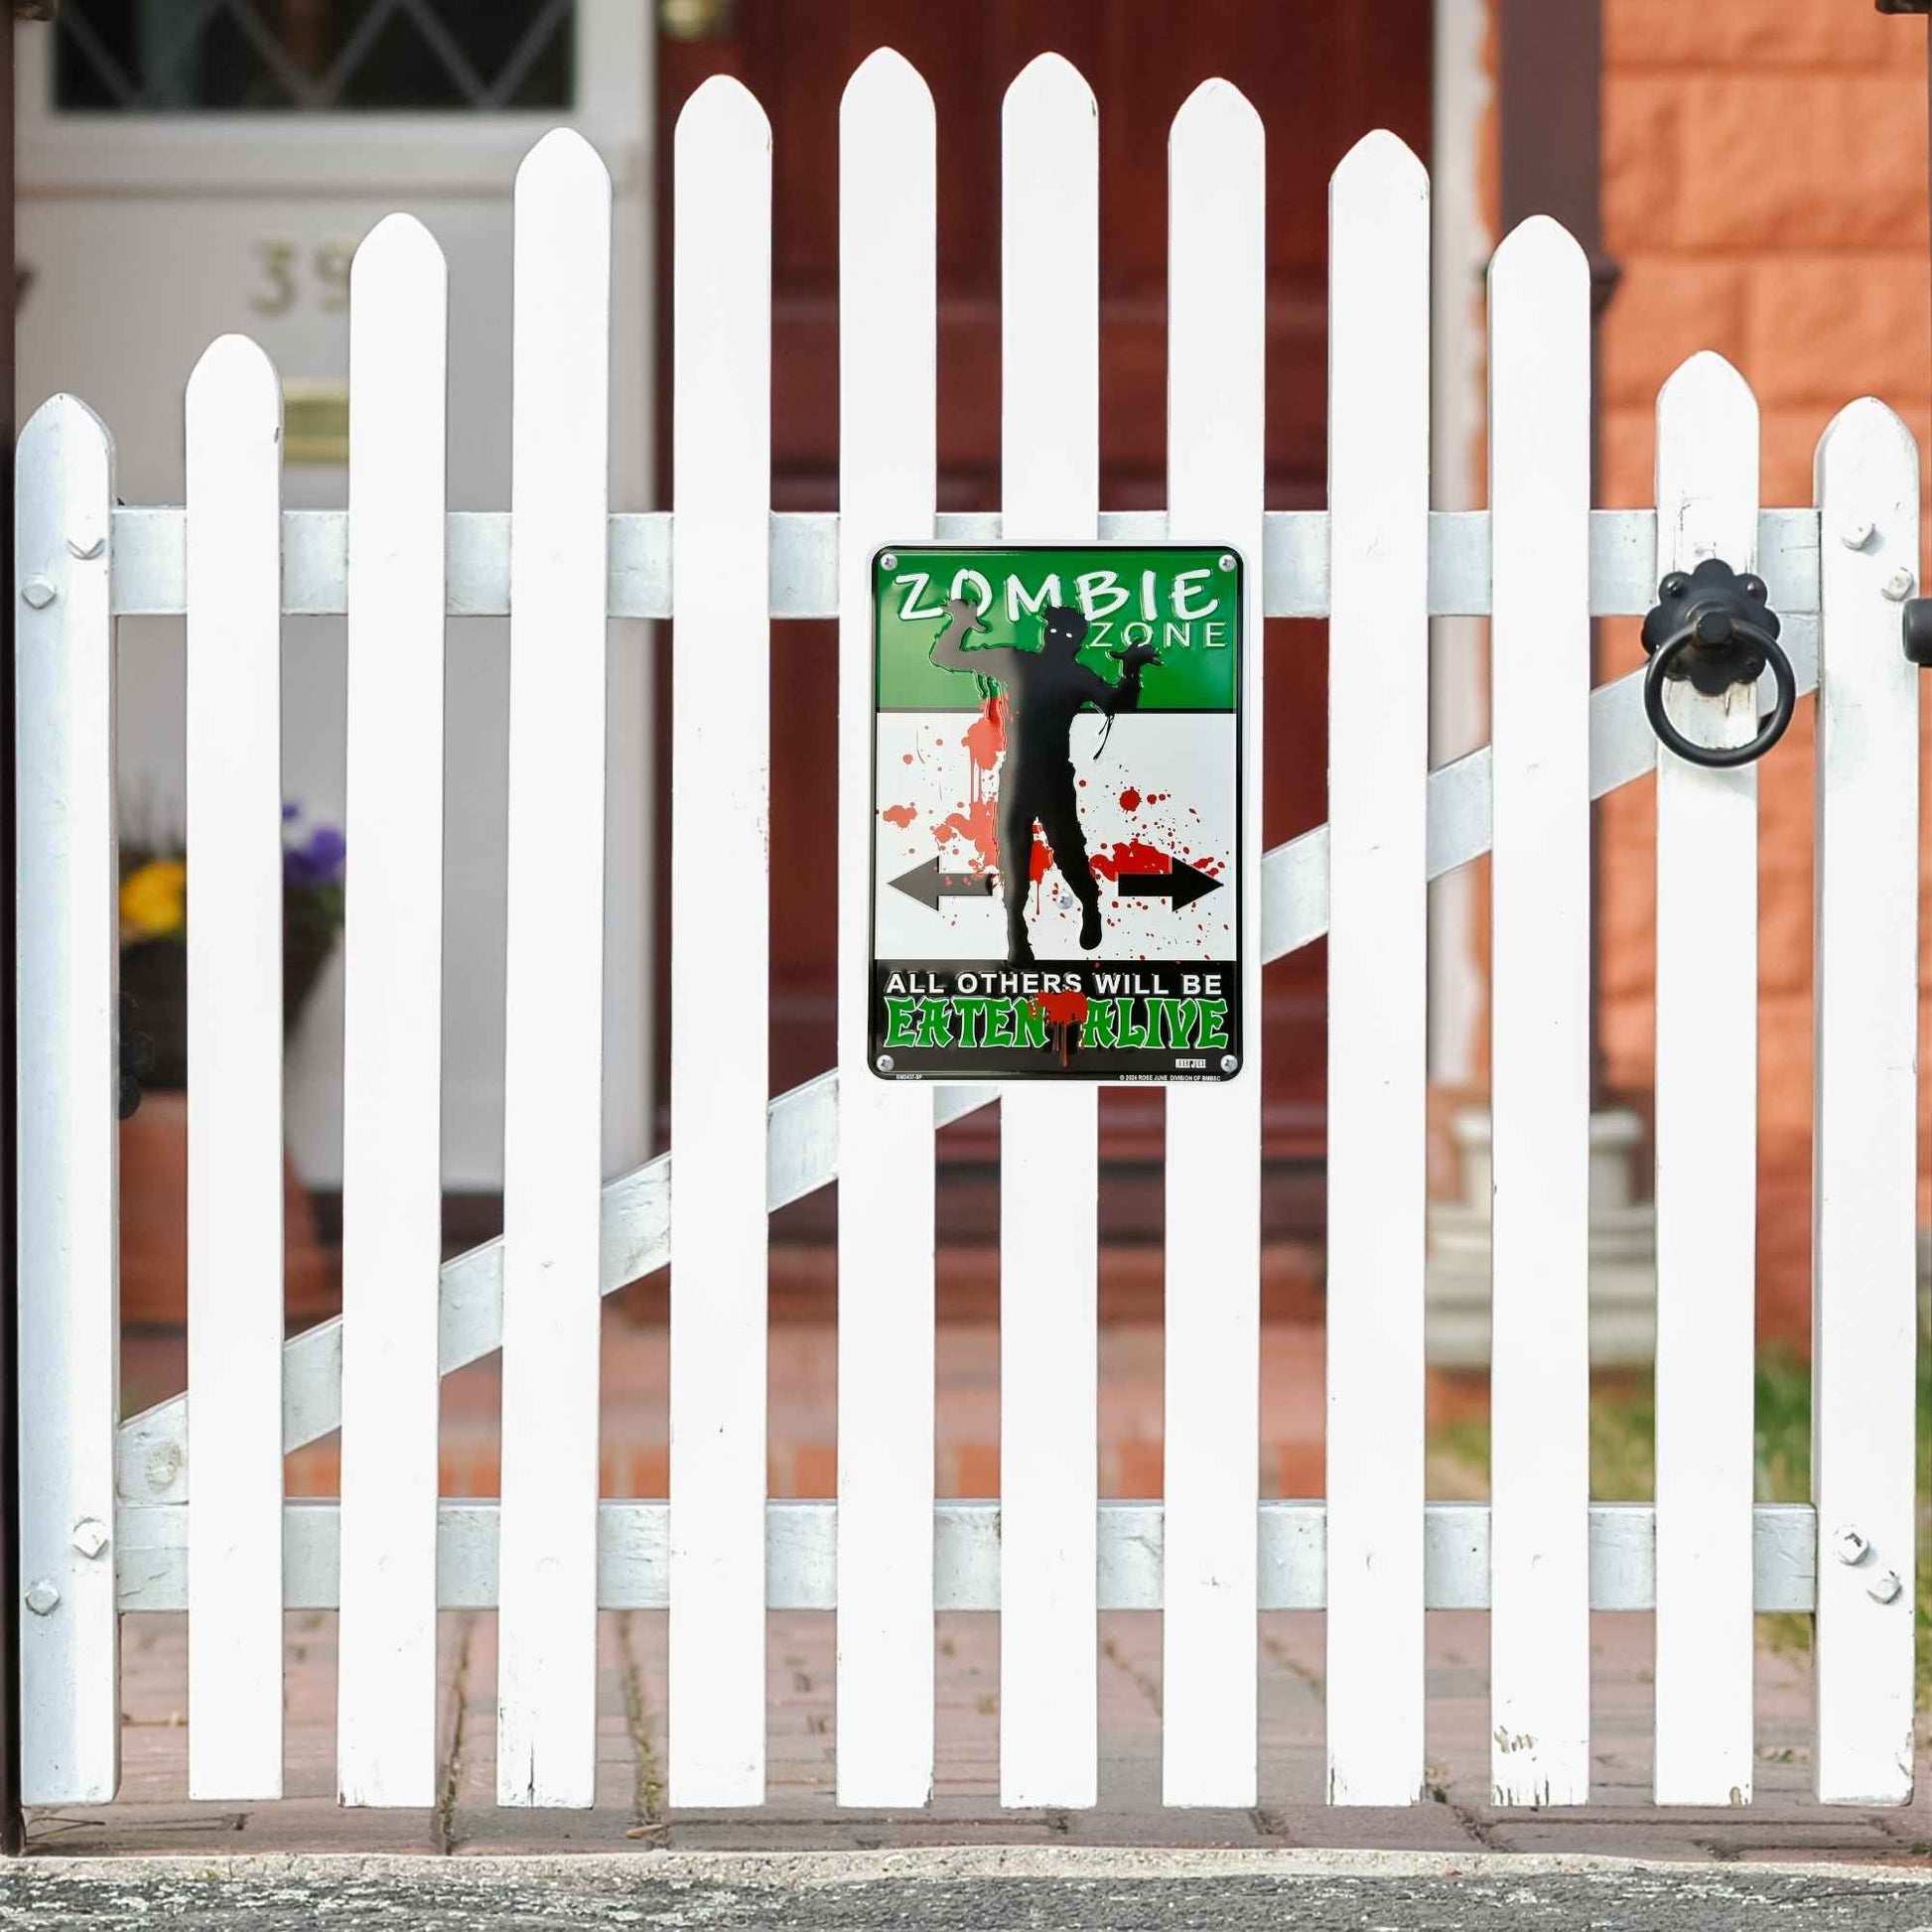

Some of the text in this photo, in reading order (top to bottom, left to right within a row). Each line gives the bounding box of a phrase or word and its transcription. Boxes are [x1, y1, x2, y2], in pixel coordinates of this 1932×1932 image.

[895, 568, 1220, 621] ZOMBIE
[1089, 621, 1227, 647] ZONE
[887, 973, 1223, 995] ALL OTHERS WILL BE
[884, 996, 1230, 1050] EATEN ALIVE
